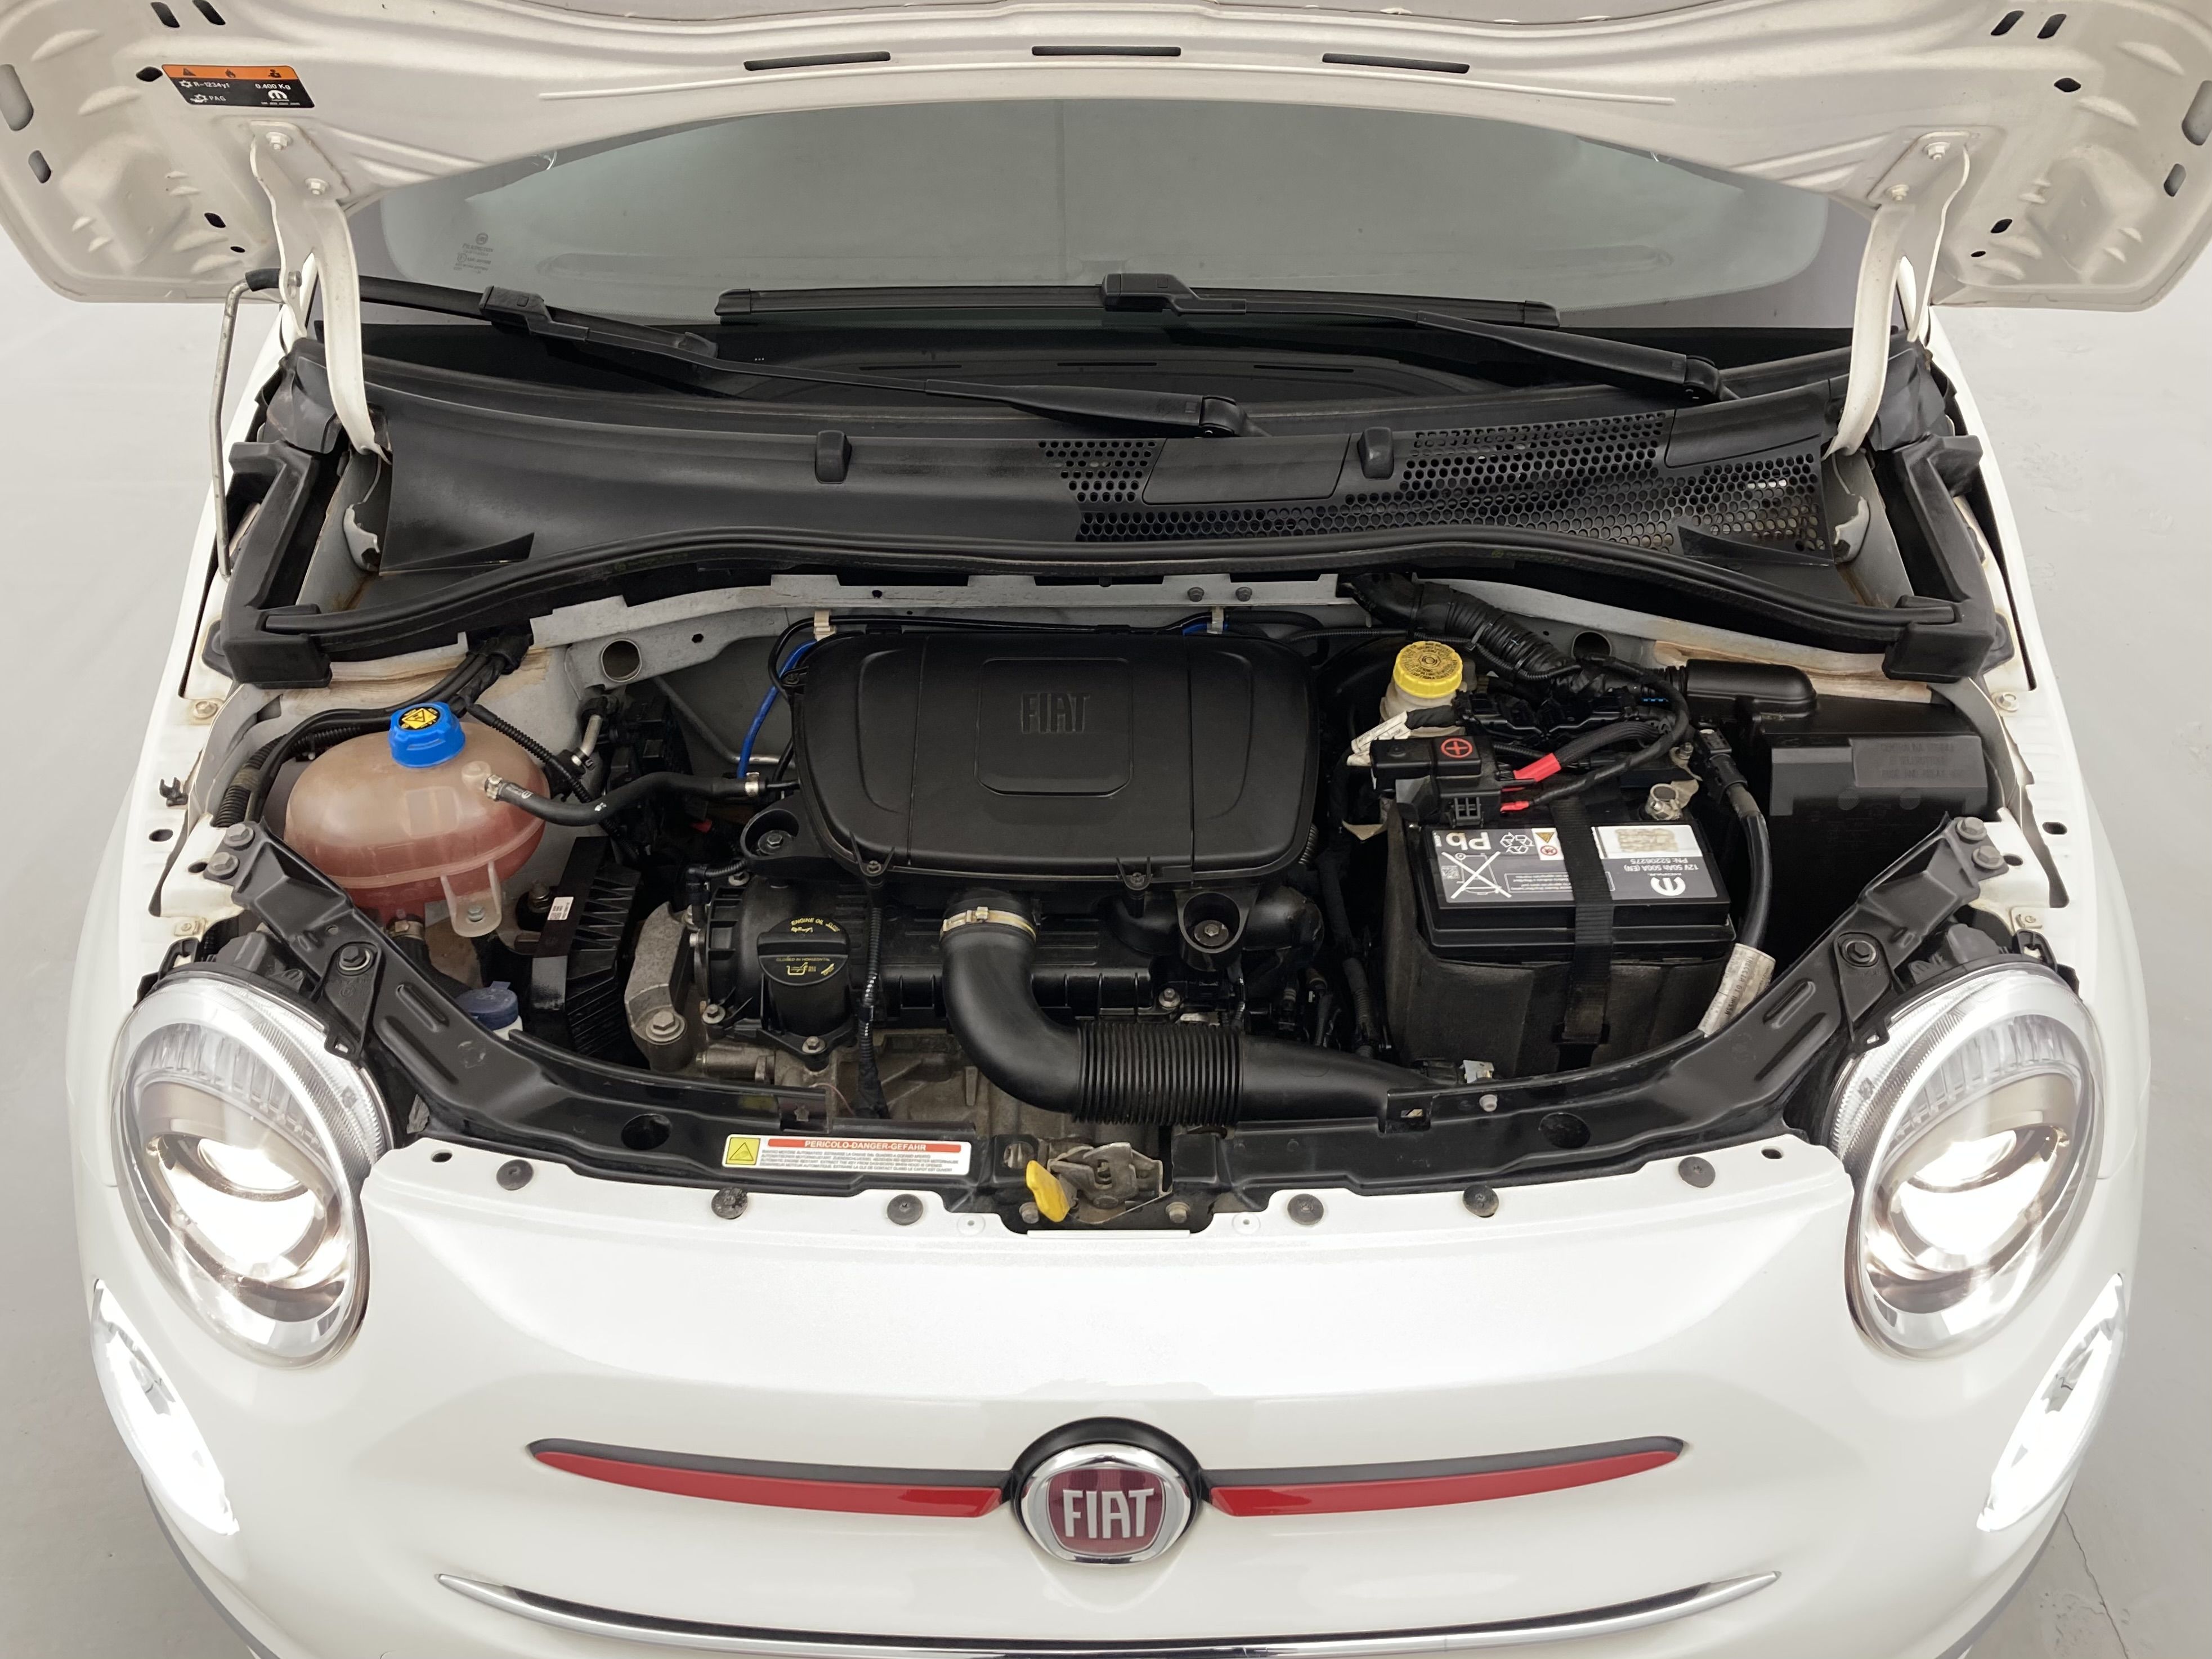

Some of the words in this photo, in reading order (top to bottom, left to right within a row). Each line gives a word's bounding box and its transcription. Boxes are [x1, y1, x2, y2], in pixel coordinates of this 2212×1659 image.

[1021, 692, 1091, 734] FIAT
[1445, 832, 1492, 851] Pb
[790, 917, 814, 926] ENGINE
[804, 1140, 926, 1151] PERICOLO-DANGER-GEFAHR
[1062, 1488, 1155, 1539] FIAT
